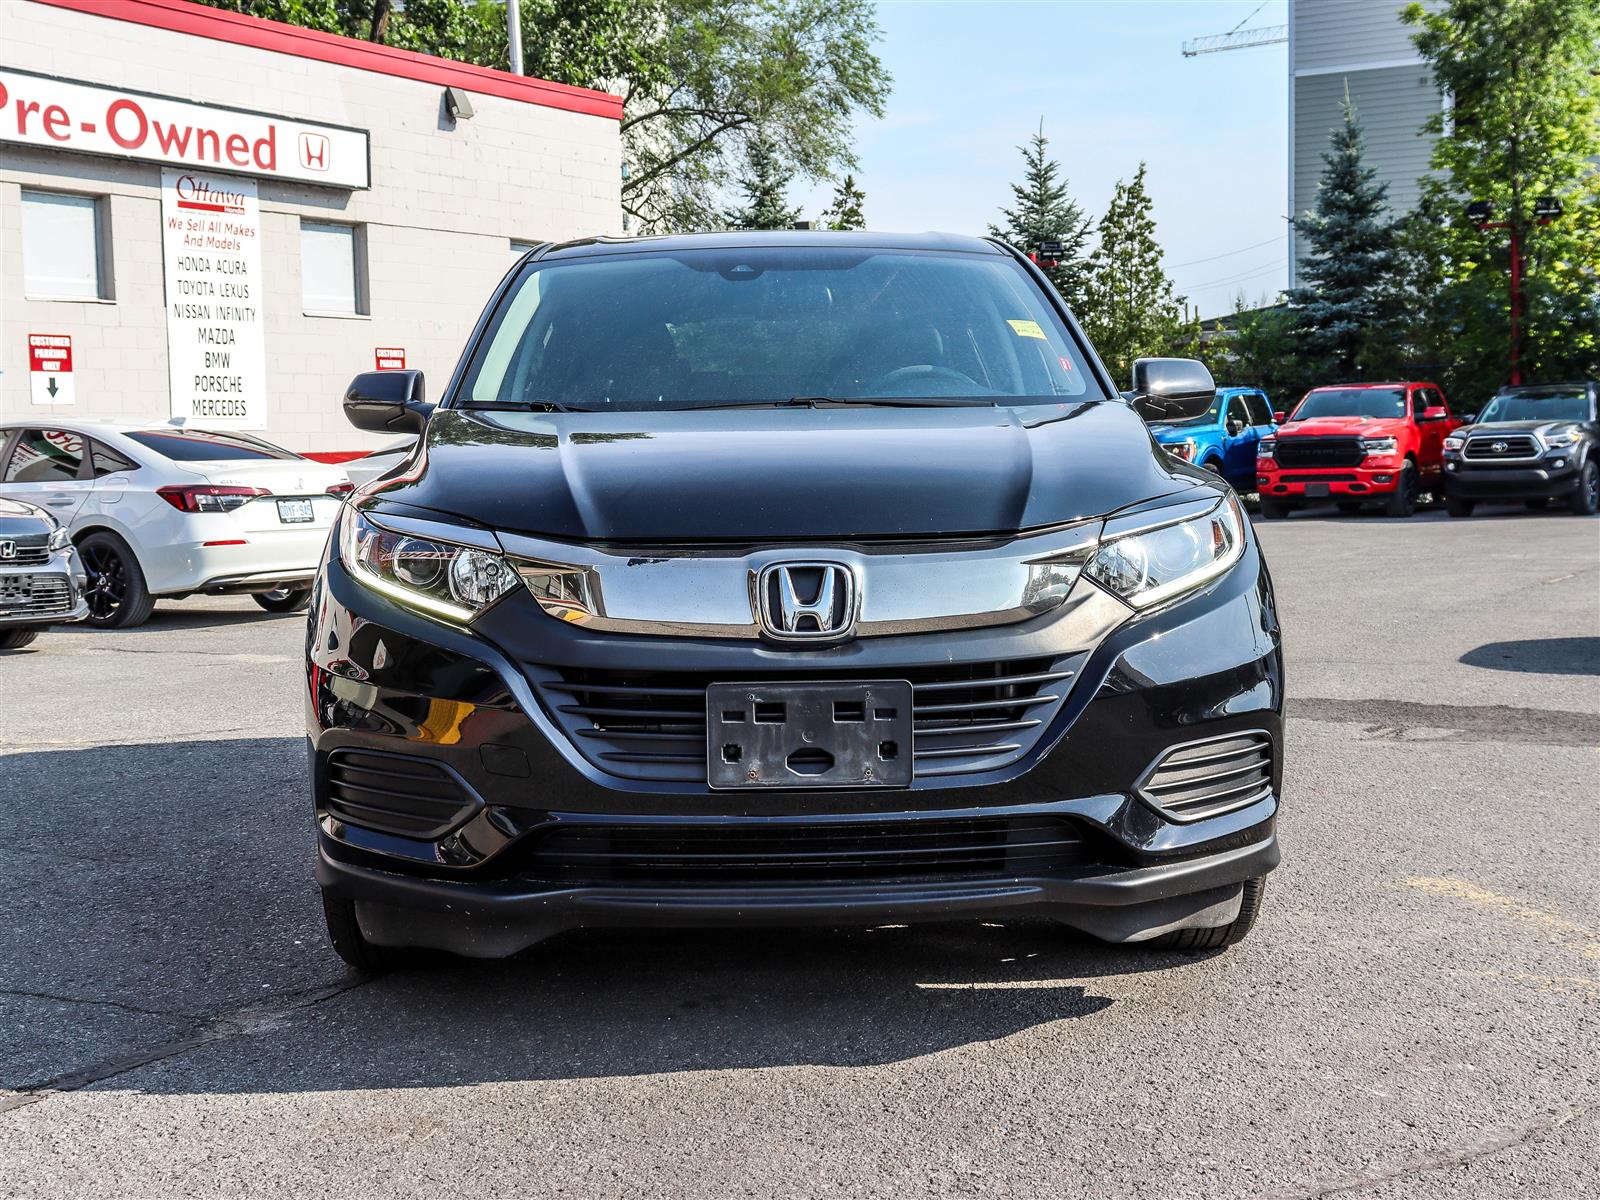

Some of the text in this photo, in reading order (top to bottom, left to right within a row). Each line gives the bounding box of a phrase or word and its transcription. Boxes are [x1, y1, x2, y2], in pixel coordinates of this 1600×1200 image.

[0, 81, 277, 171] re-Owned
[175, 174, 245, 206] Ottawa
[168, 217, 255, 237] We Sell All Makes
[183, 234, 241, 251] And Models
[177, 256, 247, 275] HONDA ACURA
[177, 280, 250, 299] TOYOTA LEXUS
[173, 303, 256, 322] NISSAN INFINITY
[198, 327, 236, 345] MAZDA
[204, 351, 230, 369] BMW
[194, 375, 243, 393] PORSCHE
[192, 399, 247, 416] MERCEDES
